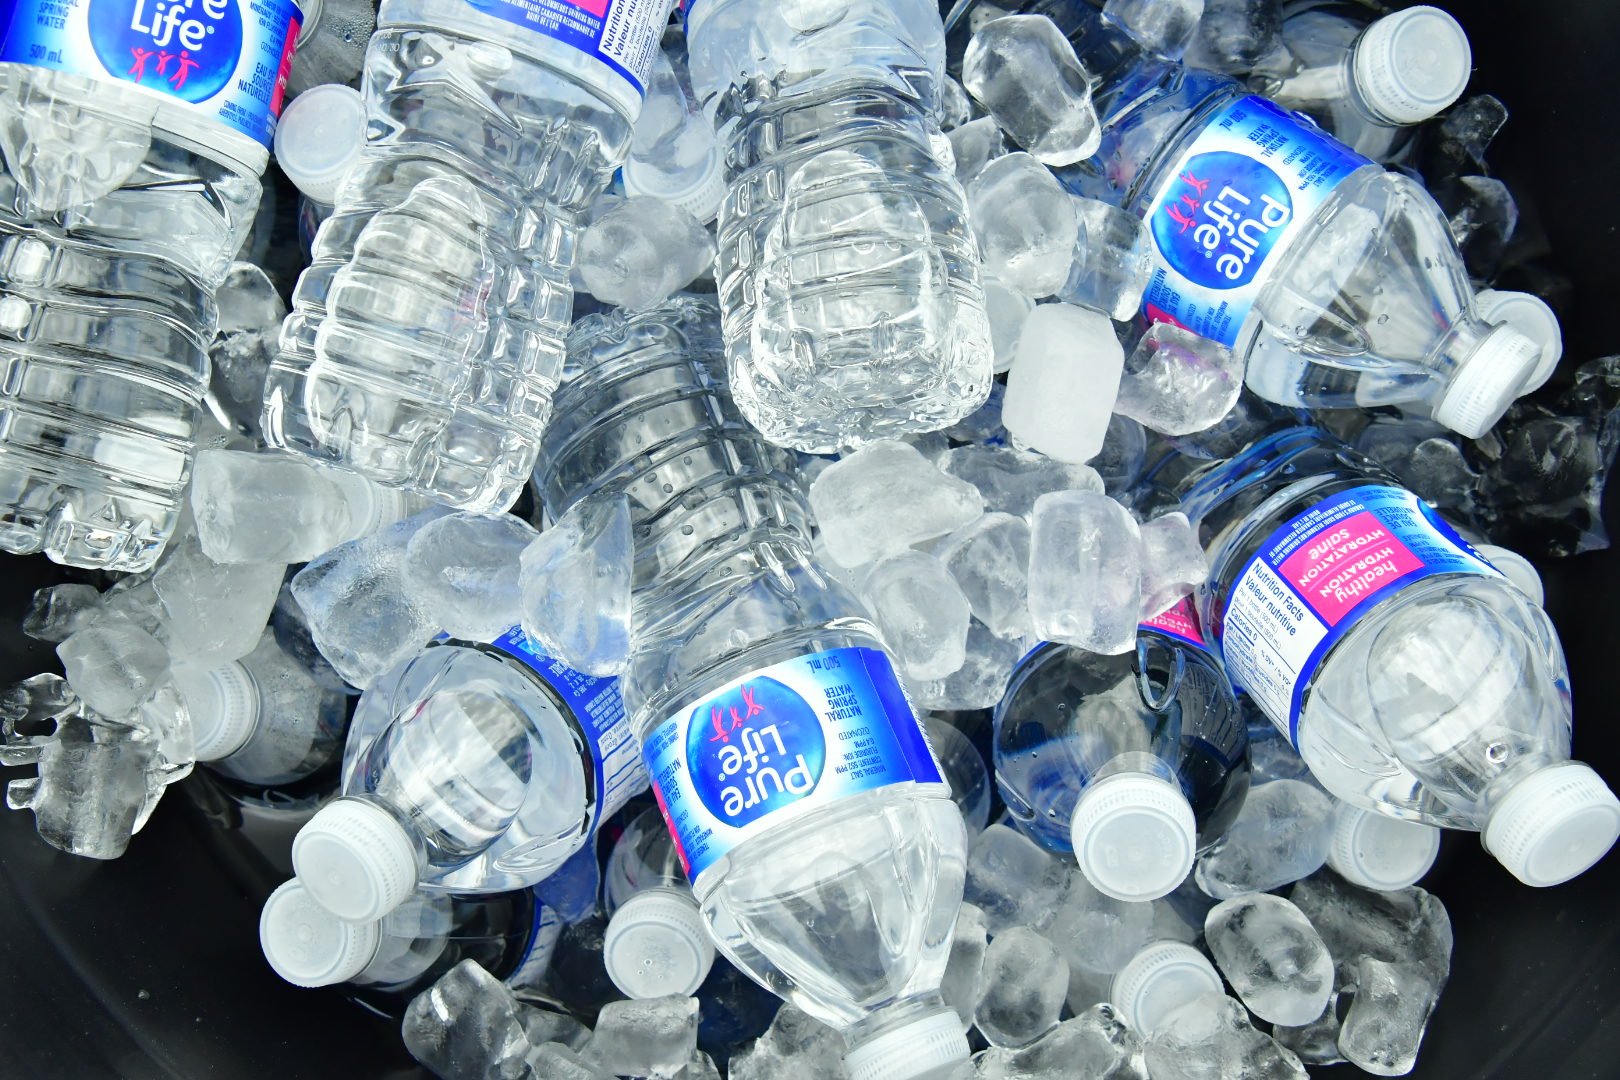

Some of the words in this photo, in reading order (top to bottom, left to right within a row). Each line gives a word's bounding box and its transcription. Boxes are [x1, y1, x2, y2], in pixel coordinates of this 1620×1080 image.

[39, 2, 69, 18] SPRING
[37, 14, 66, 30] WATER
[603, 0, 626, 51] Nutrition
[614, 19, 631, 56] Valeur
[28, 43, 47, 60] 500
[47, 49, 62, 64] mL
[635, 35, 650, 73] Calories
[255, 62, 268, 77] EAU
[238, 78, 269, 105] NATURELLE
[252, 73, 272, 94] SOURCE
[1219, 117, 1233, 131] mL
[1247, 123, 1272, 142] WATER
[1256, 129, 1280, 148] SPRING
[1261, 135, 1289, 158] NATURAL
[1216, 194, 1290, 279] Pure
[1149, 267, 1167, 302] NATURELLE
[1159, 285, 1171, 310] SOURCE
[1170, 292, 1181, 305] EAU
[1373, 506, 1415, 515] NATURELLE
[1382, 513, 1410, 521] SOURCE
[1308, 528, 1350, 559] saine
[1298, 529, 1385, 586] HYDRATATION
[1320, 547, 1394, 597] HYDRATION
[1335, 561, 1397, 603] healthy
[1253, 563, 1285, 600] Nutrition
[1283, 596, 1304, 621] Facts
[1245, 575, 1268, 603] Valeur
[1266, 602, 1296, 636] nutritive
[1231, 608, 1253, 636] Calories
[1252, 633, 1257, 641] 0
[807, 660, 822, 674] mL
[823, 656, 841, 670] 500
[824, 683, 853, 698] WATER
[828, 694, 858, 710] SPRING
[825, 705, 862, 722] NATURAL
[838, 726, 870, 741] OZONATED
[720, 754, 815, 817] Pure
